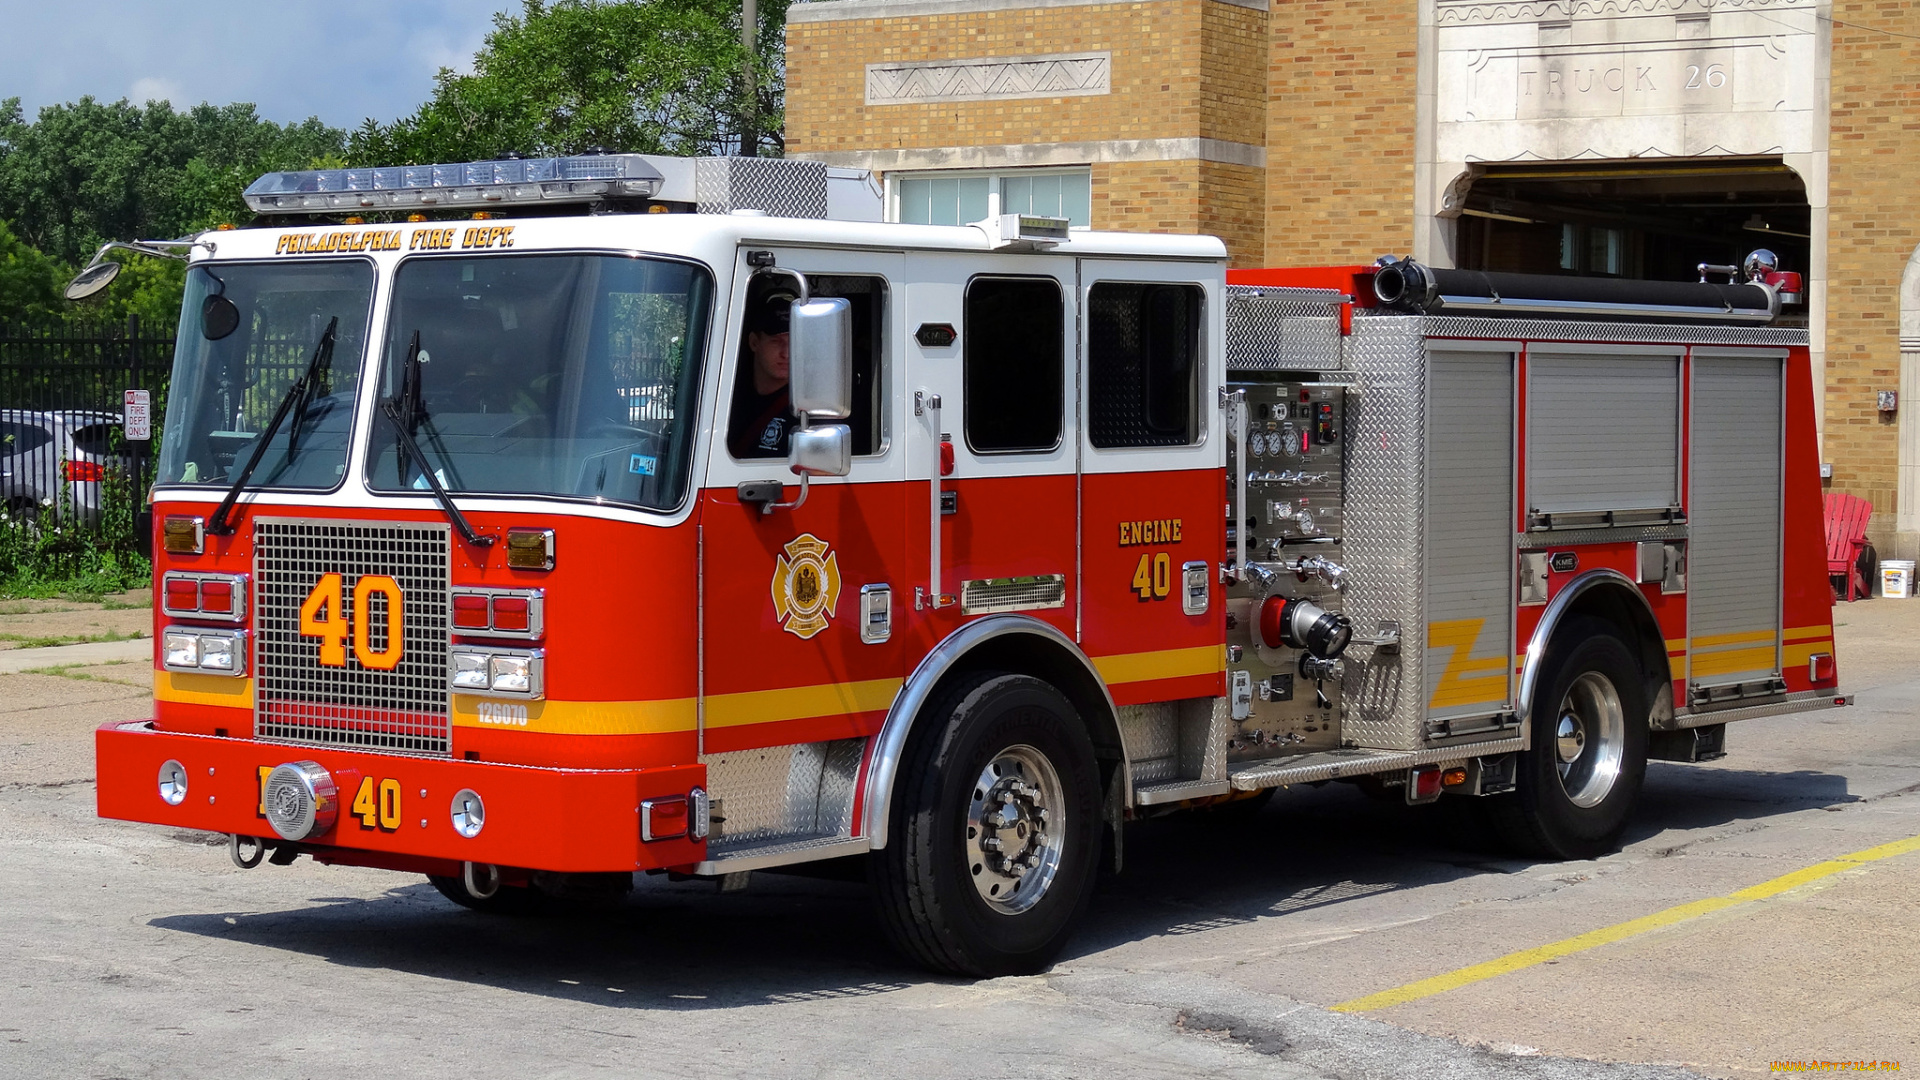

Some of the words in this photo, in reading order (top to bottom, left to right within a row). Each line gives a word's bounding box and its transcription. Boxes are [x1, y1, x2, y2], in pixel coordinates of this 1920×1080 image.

[1520, 66, 1657, 95] TRUCK
[1684, 63, 1727, 91] 26
[276, 230, 401, 254] PHILADELPHIA
[409, 228, 457, 250] FIRE
[462, 225, 515, 249] DEPT.
[923, 330, 949, 341] KME
[130, 406, 145, 415] FIRE
[128, 427, 147, 436] ONLY
[1119, 518, 1182, 546] ENGINE
[1555, 558, 1573, 566] KME
[1131, 552, 1170, 601] 40
[300, 572, 403, 670] 40
[477, 702, 528, 727] 126070
[352, 775, 402, 831] 40
